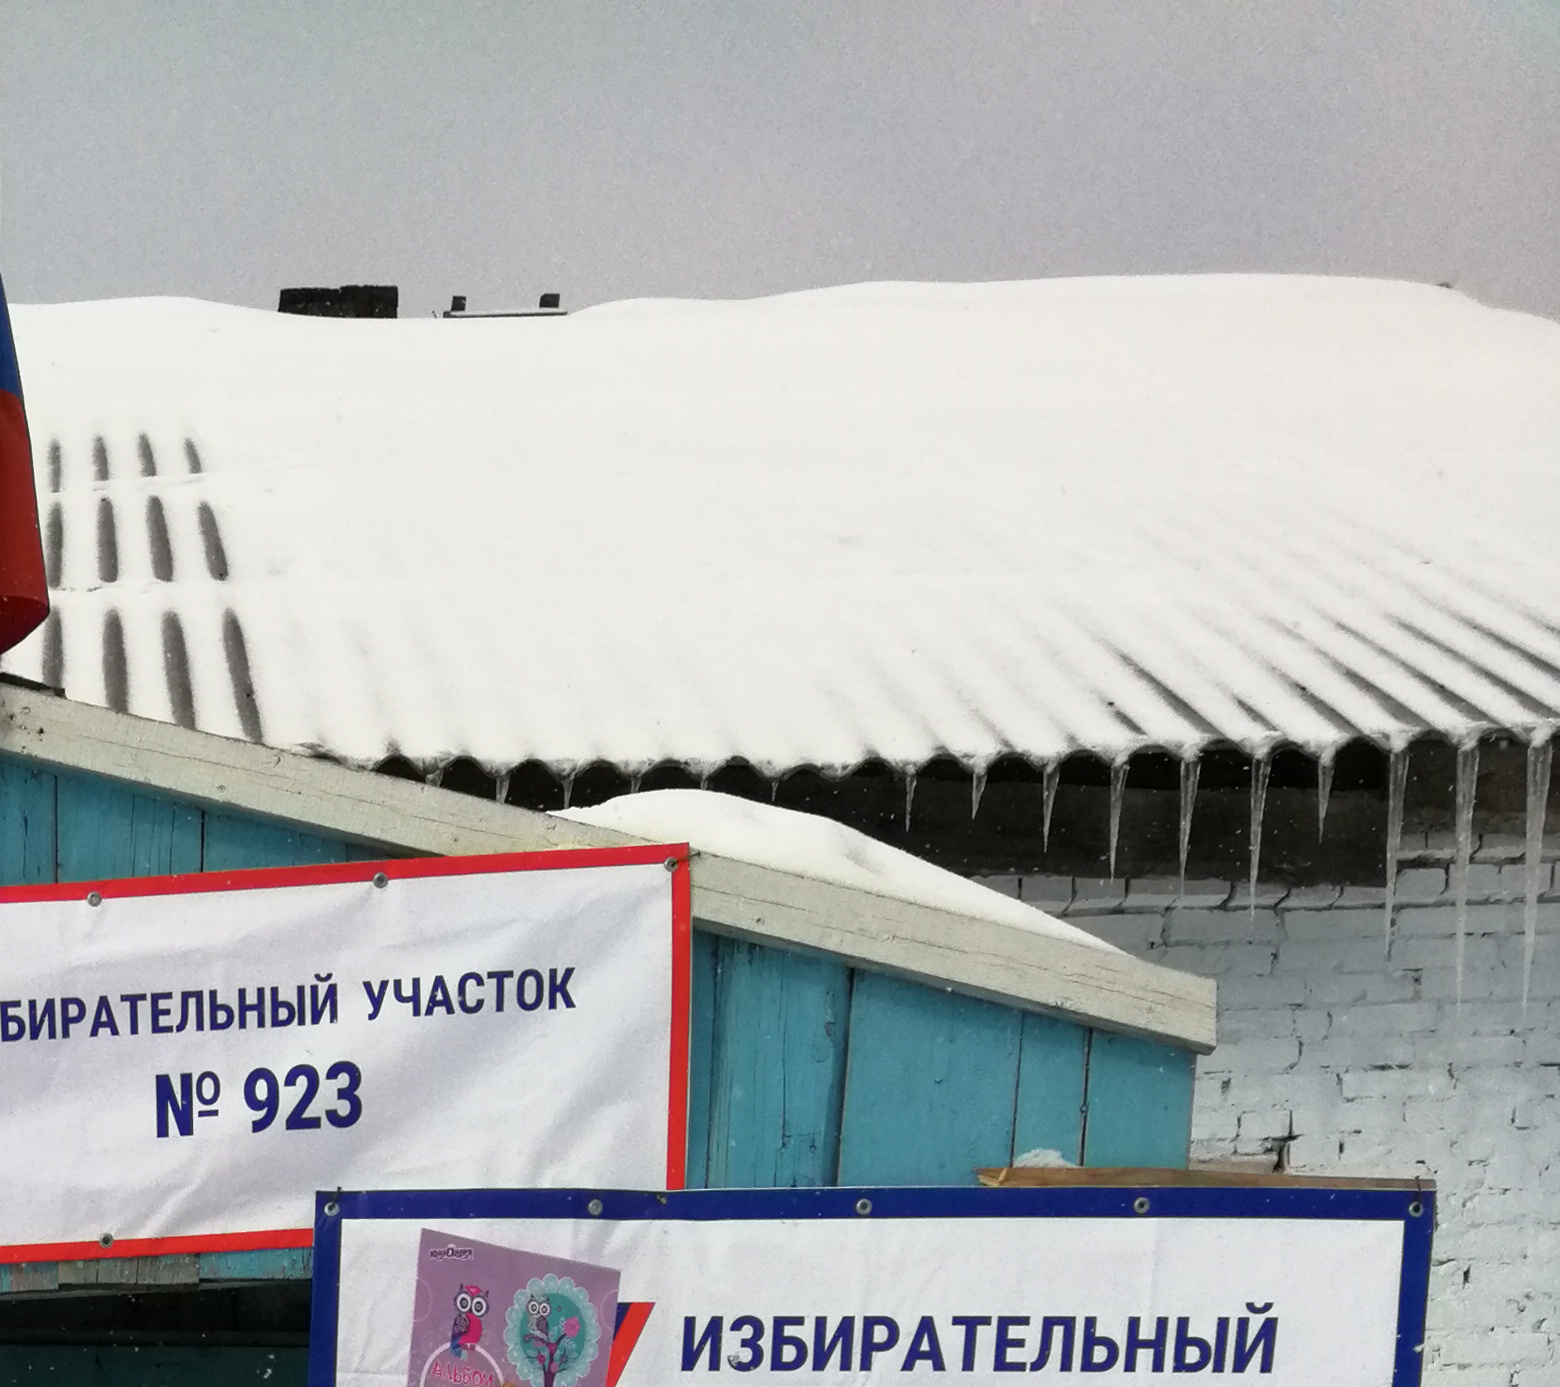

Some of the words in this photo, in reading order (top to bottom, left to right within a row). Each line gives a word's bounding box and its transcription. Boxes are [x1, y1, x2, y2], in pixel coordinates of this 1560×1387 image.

[362, 967, 576, 1021] УЧАСТОК
[156, 1071, 220, 1138] №
[243, 1060, 363, 1134] 923
[680, 1302, 1279, 1374] ИЗБИРАТЕЛЬНЫЙ
